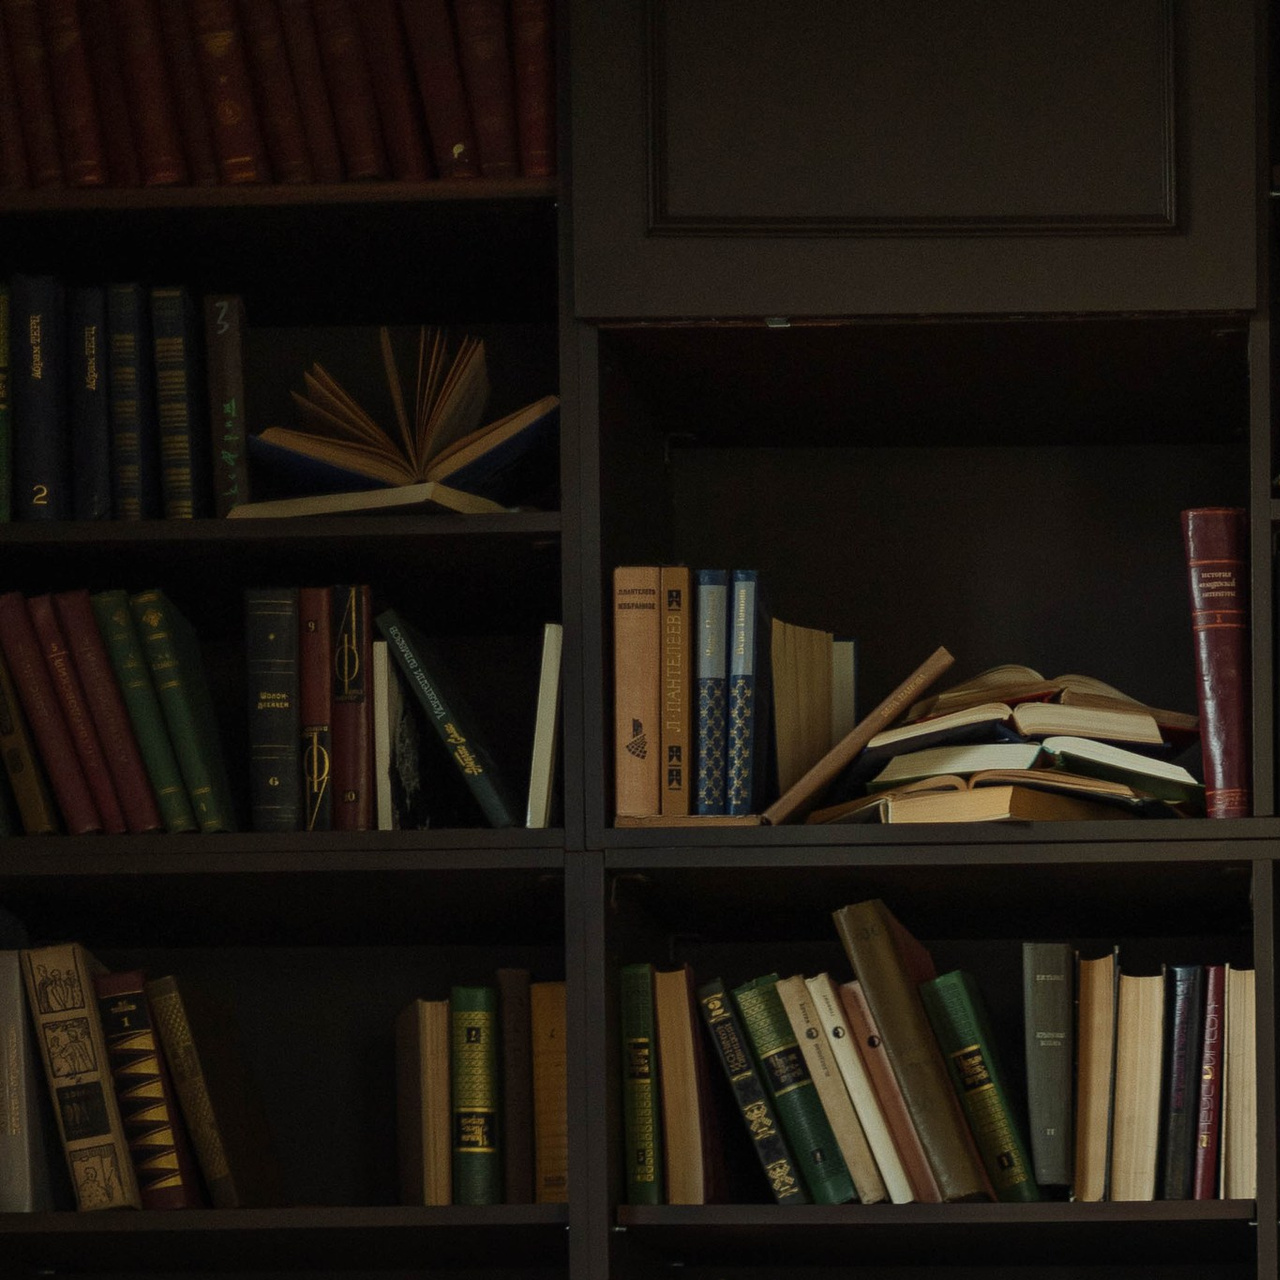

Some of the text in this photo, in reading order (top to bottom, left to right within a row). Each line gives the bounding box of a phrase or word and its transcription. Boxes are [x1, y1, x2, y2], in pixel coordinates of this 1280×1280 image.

[32, 485, 48, 505] 2
[388, 625, 447, 721] Искатели алмазов
